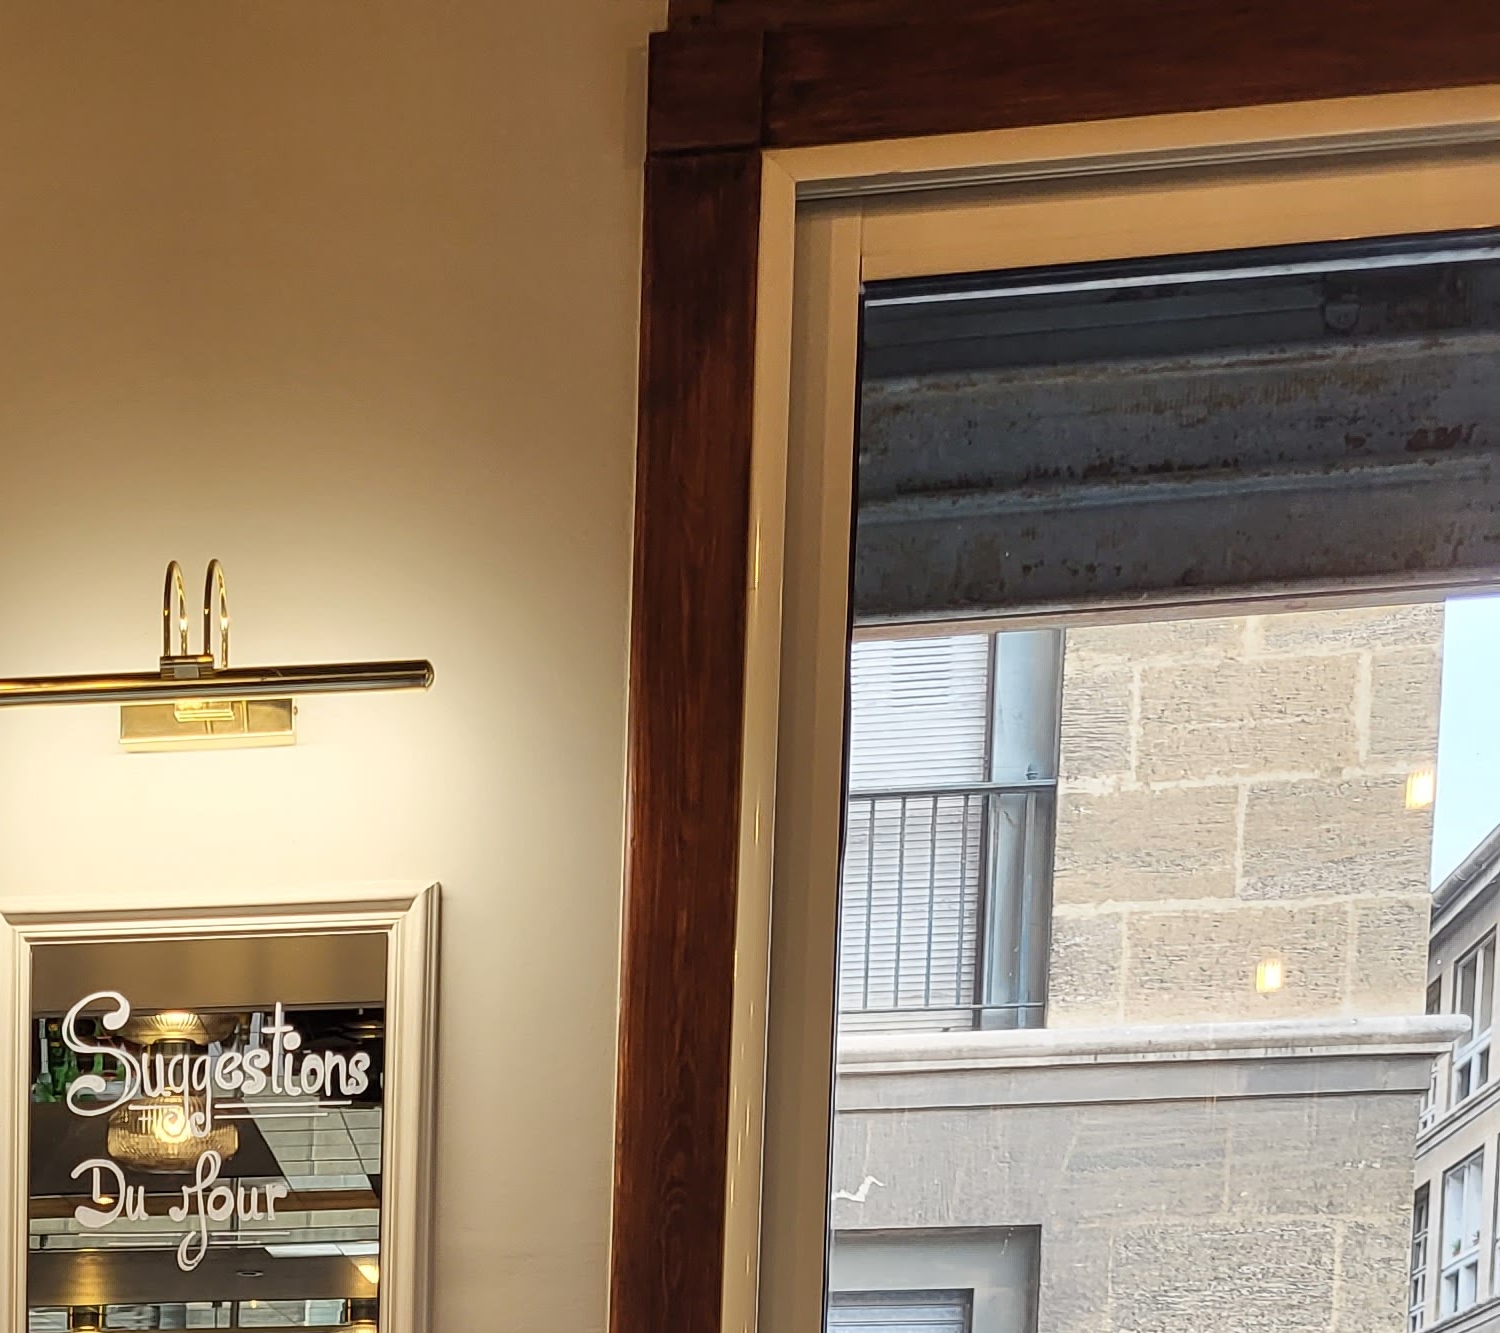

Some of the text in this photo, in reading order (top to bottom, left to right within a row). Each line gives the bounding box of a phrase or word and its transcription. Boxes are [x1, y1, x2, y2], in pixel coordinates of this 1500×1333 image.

[62, 991, 371, 1138] Suggestions
[70, 1150, 288, 1272] Du Jour
